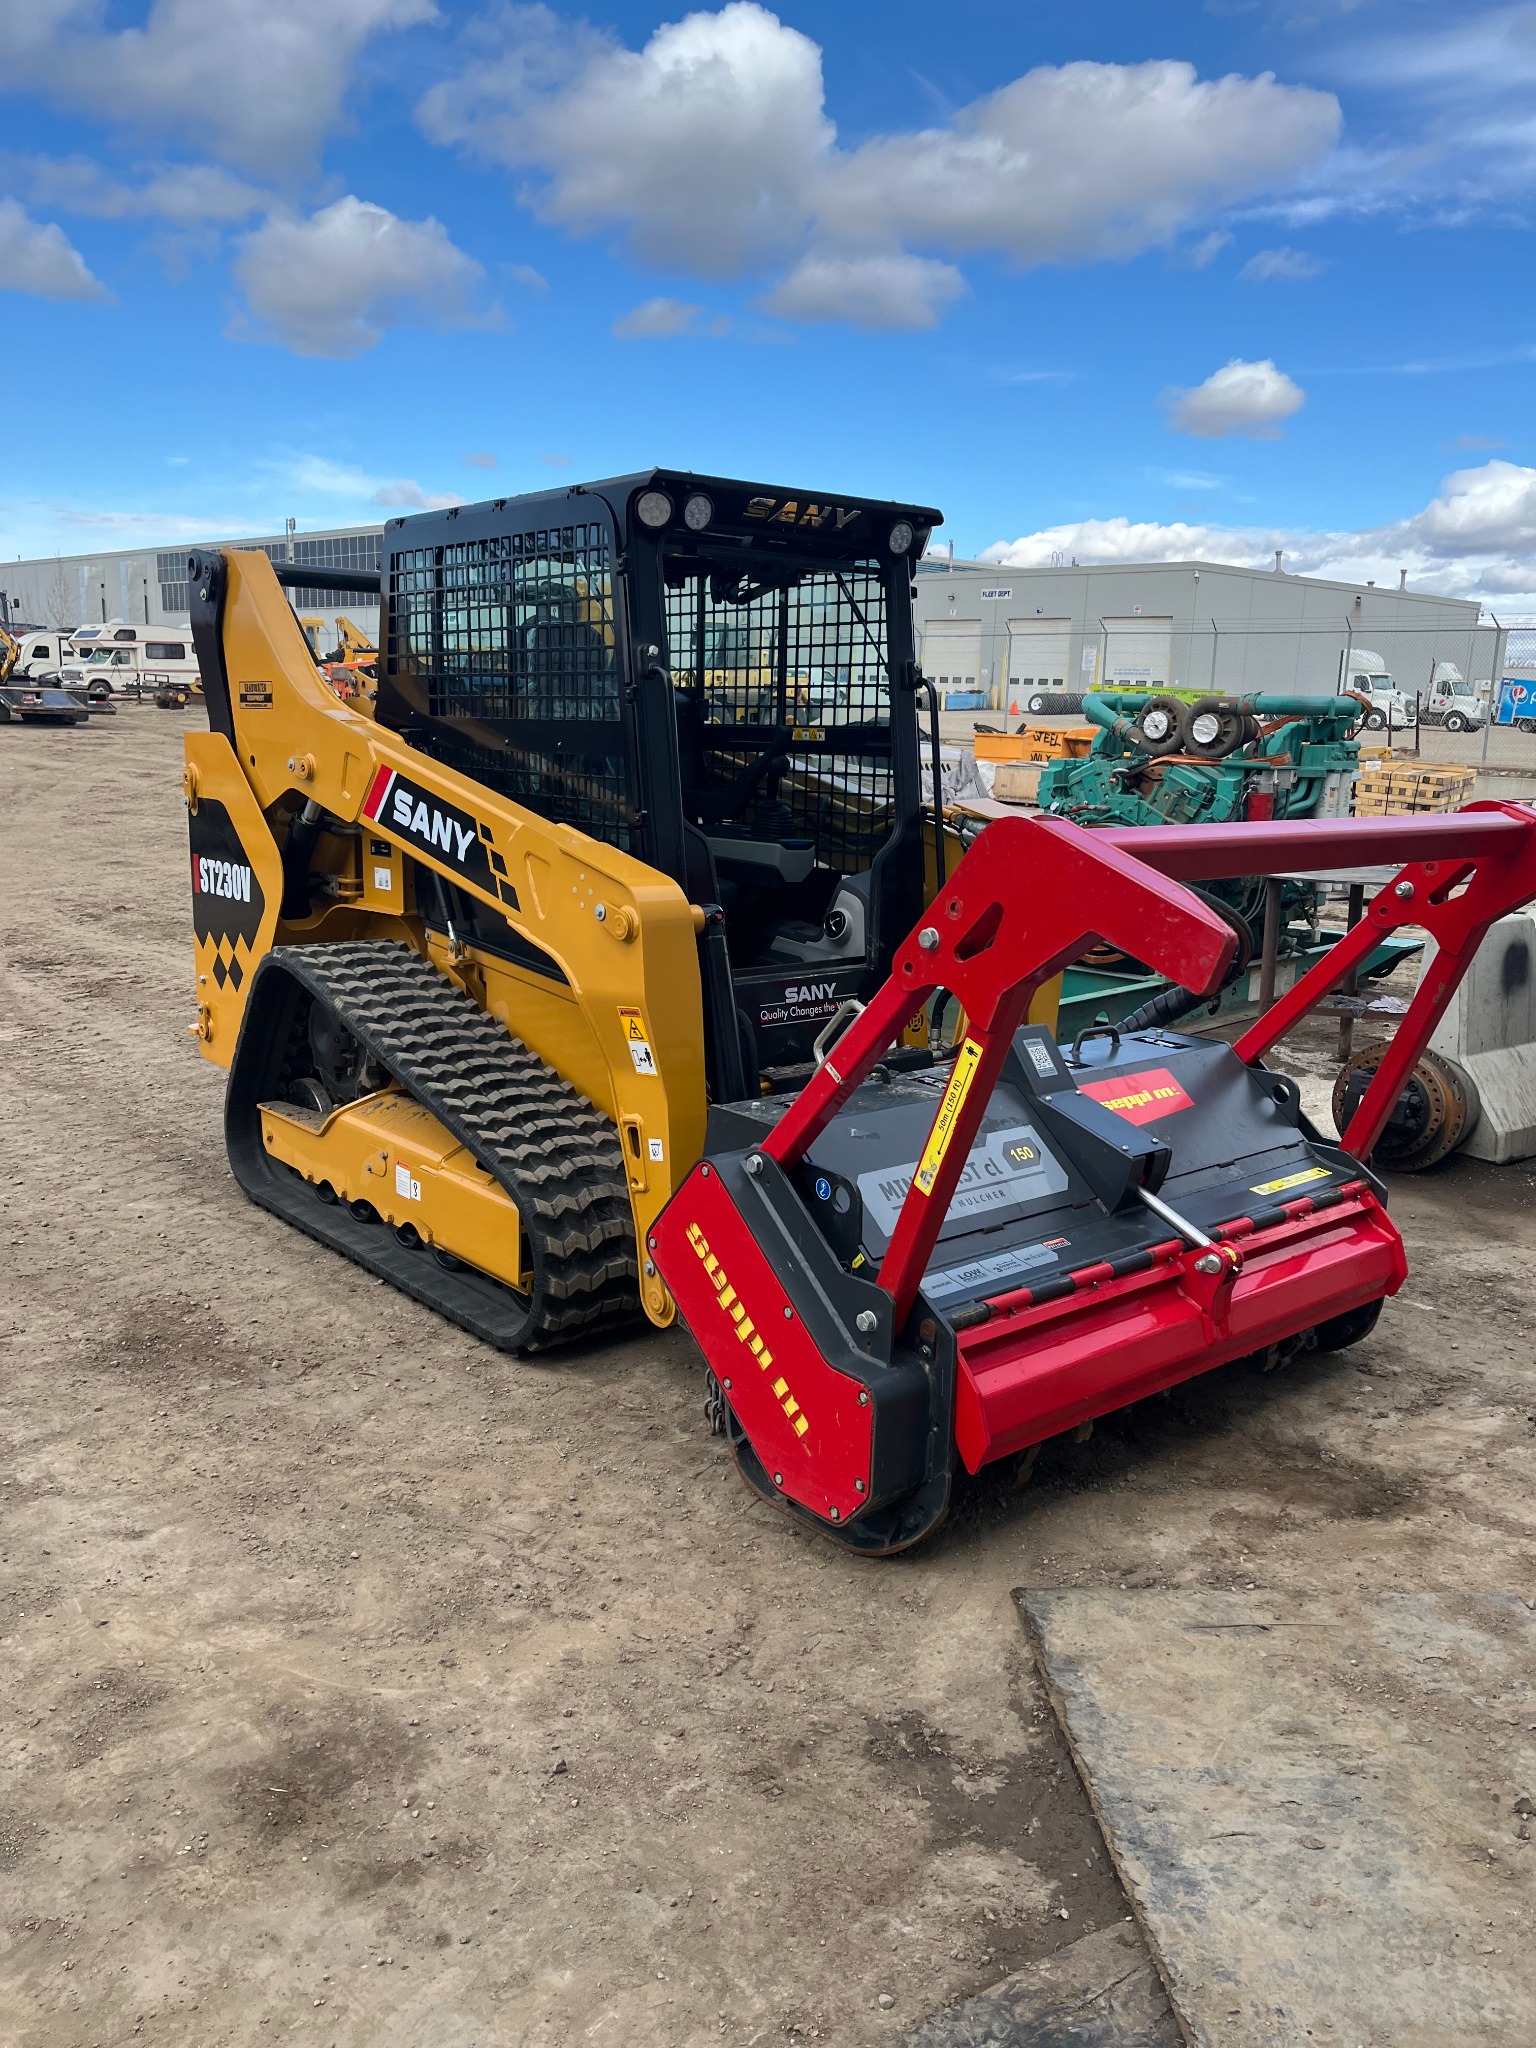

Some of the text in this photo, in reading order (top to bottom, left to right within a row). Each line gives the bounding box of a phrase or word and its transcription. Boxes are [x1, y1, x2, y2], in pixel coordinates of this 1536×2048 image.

[742, 497, 861, 531] SANY
[982, 590, 997, 598] FLEET
[1033, 731, 1061, 747] STEEL
[393, 788, 476, 862] SANY
[199, 856, 251, 903] ST230V
[785, 983, 837, 1004] SANY
[760, 1008, 788, 1021] Quality
[790, 1005, 822, 1017] Changes
[823, 1002, 835, 1013] the
[938, 1079, 963, 1132] 50m (150 ft)
[1099, 1090, 1154, 1110] seppi
[1010, 1146, 1035, 1162] 150
[957, 1189, 1006, 1209] MULCHER
[957, 1268, 981, 1279] LOW
[685, 1221, 774, 1371] seppi
